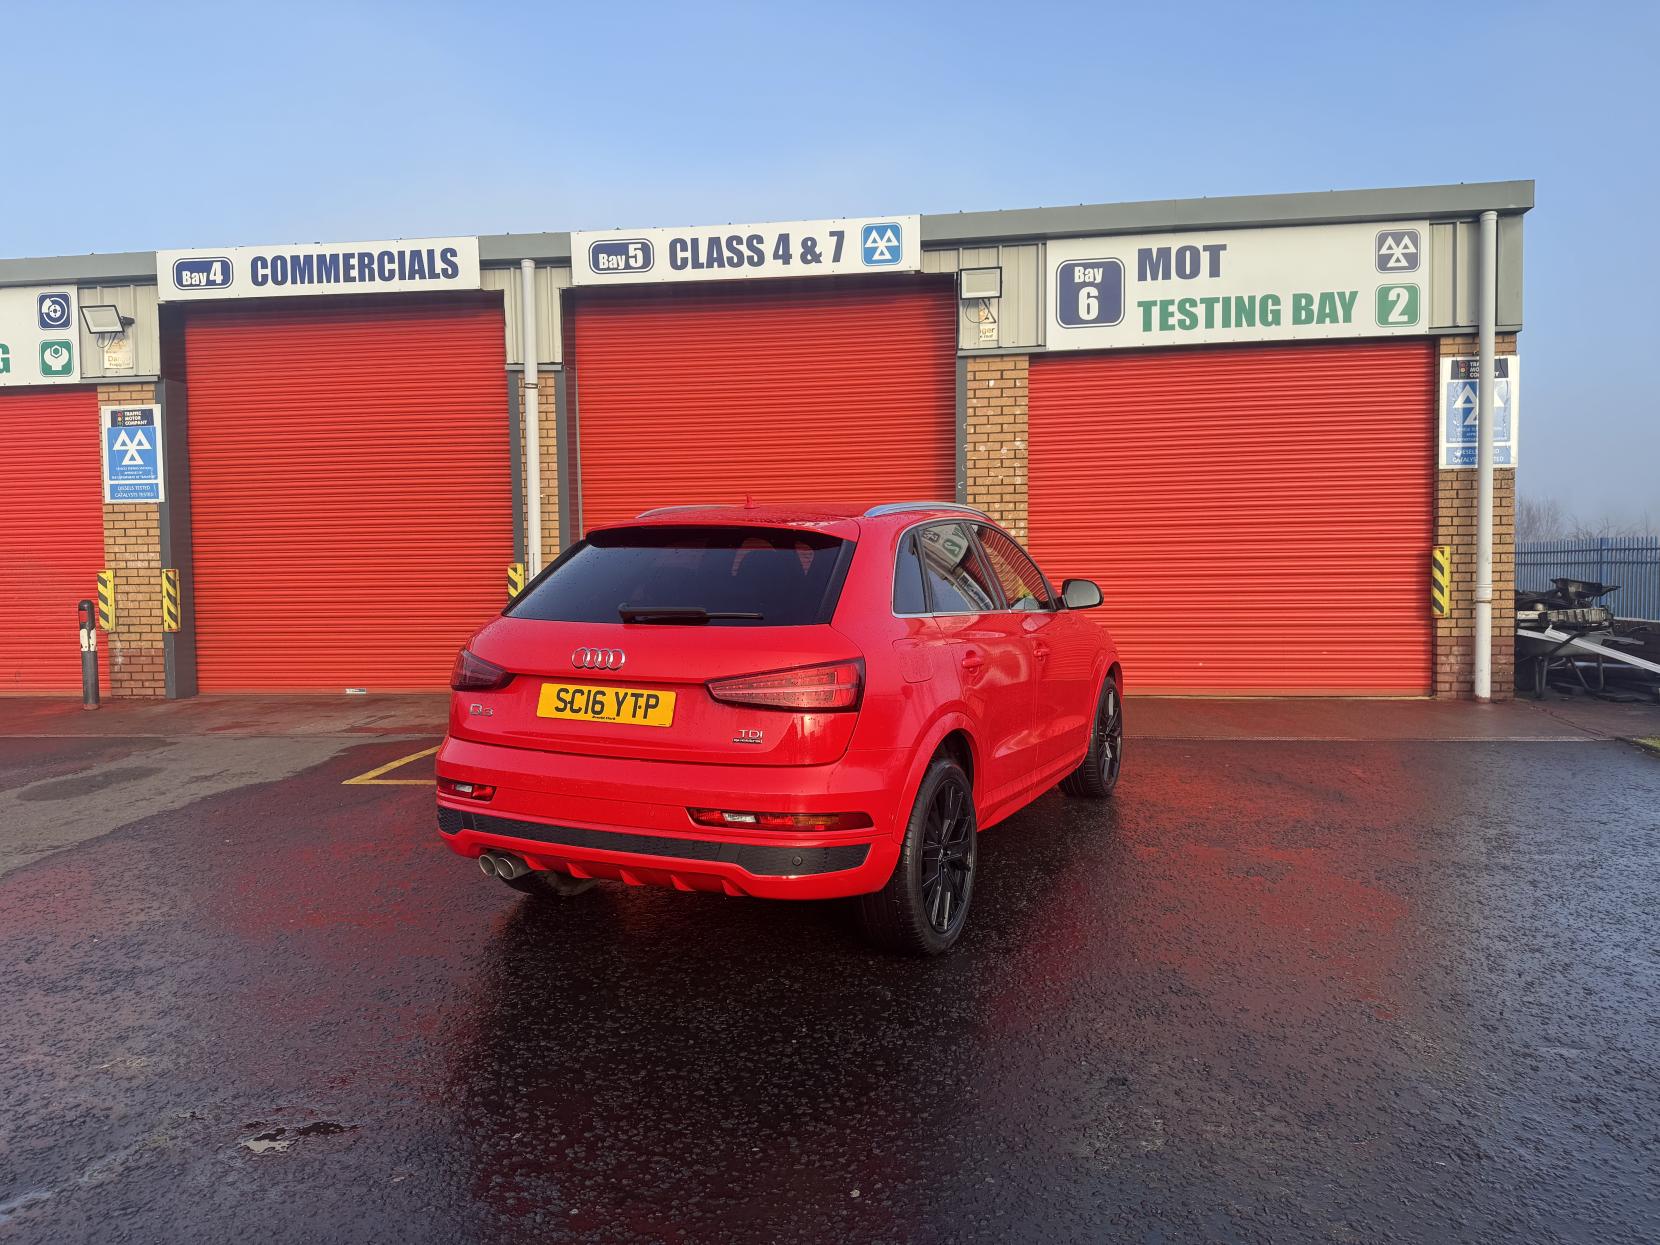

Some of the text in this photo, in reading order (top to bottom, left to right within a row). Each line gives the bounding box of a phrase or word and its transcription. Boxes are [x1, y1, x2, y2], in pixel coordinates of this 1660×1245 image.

[250, 247, 459, 287] COMMERCIALS
[599, 243, 644, 269] Bay 5
[668, 230, 845, 271] CLASS 4 & 7
[1137, 243, 1227, 282] MOT
[182, 262, 223, 287] Bay 4
[1074, 266, 1103, 284] Bay
[1078, 286, 1099, 321] 6
[1137, 290, 1359, 333] TESTING BAY
[1387, 287, 1409, 323] 2
[554, 688, 660, 719] SC16 YTP
[737, 729, 763, 738] TDI
